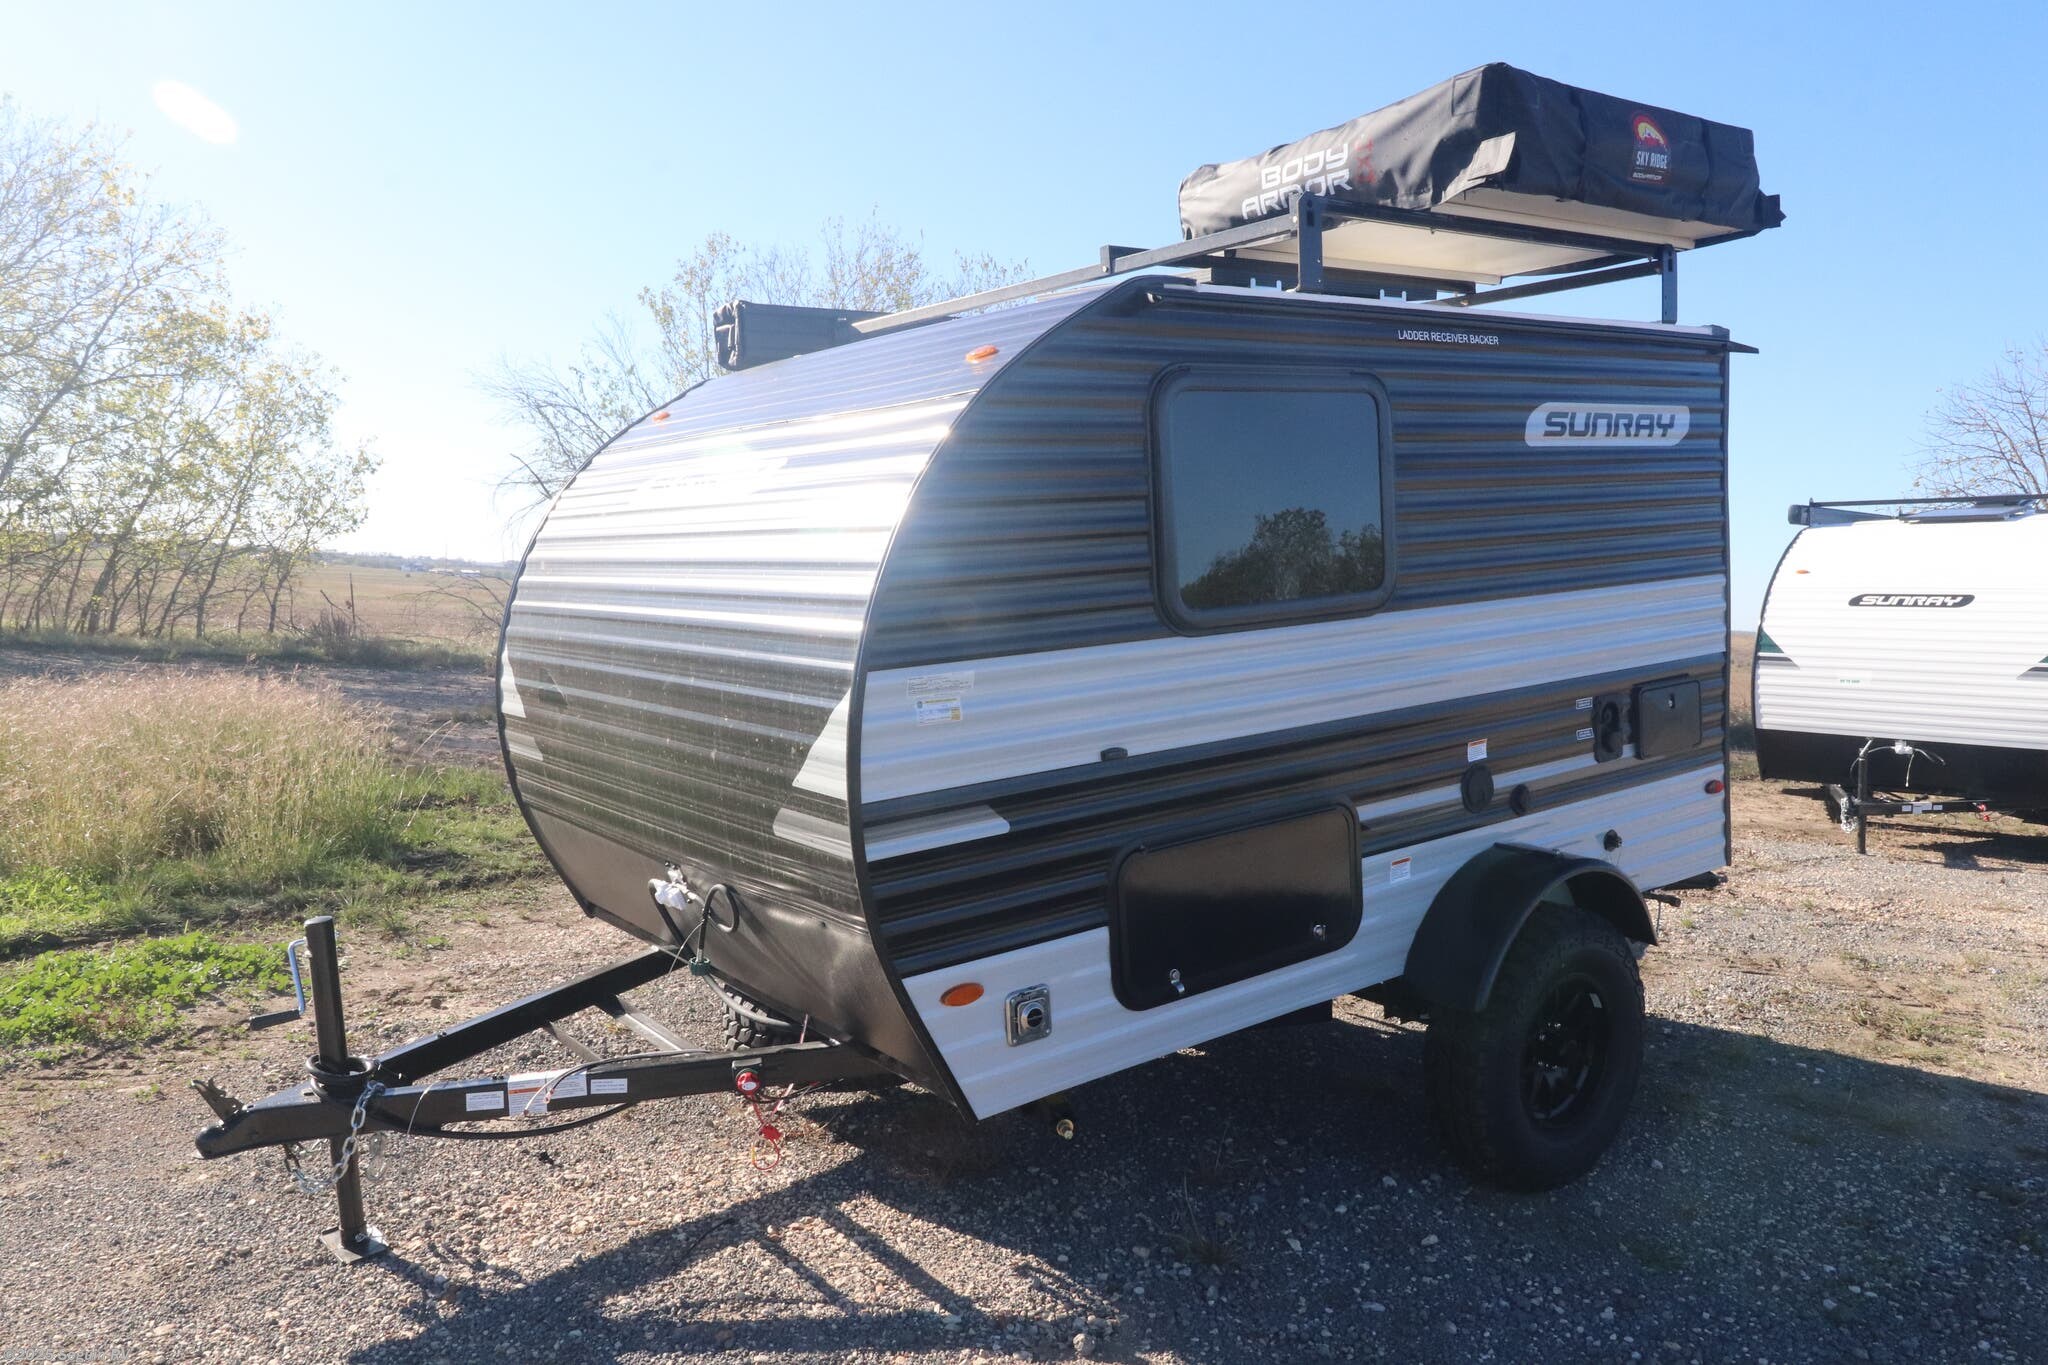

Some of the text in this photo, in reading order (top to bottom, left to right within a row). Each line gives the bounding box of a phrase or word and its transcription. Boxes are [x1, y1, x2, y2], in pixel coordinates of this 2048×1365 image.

[1261, 142, 1348, 190] BODY
[1636, 150, 1668, 169] SKY RIDGE
[1397, 329, 1499, 345] LADDER RECEIVER BACKER
[1543, 411, 1676, 438] SUNRAY
[1859, 595, 1963, 606] SUNRAY
